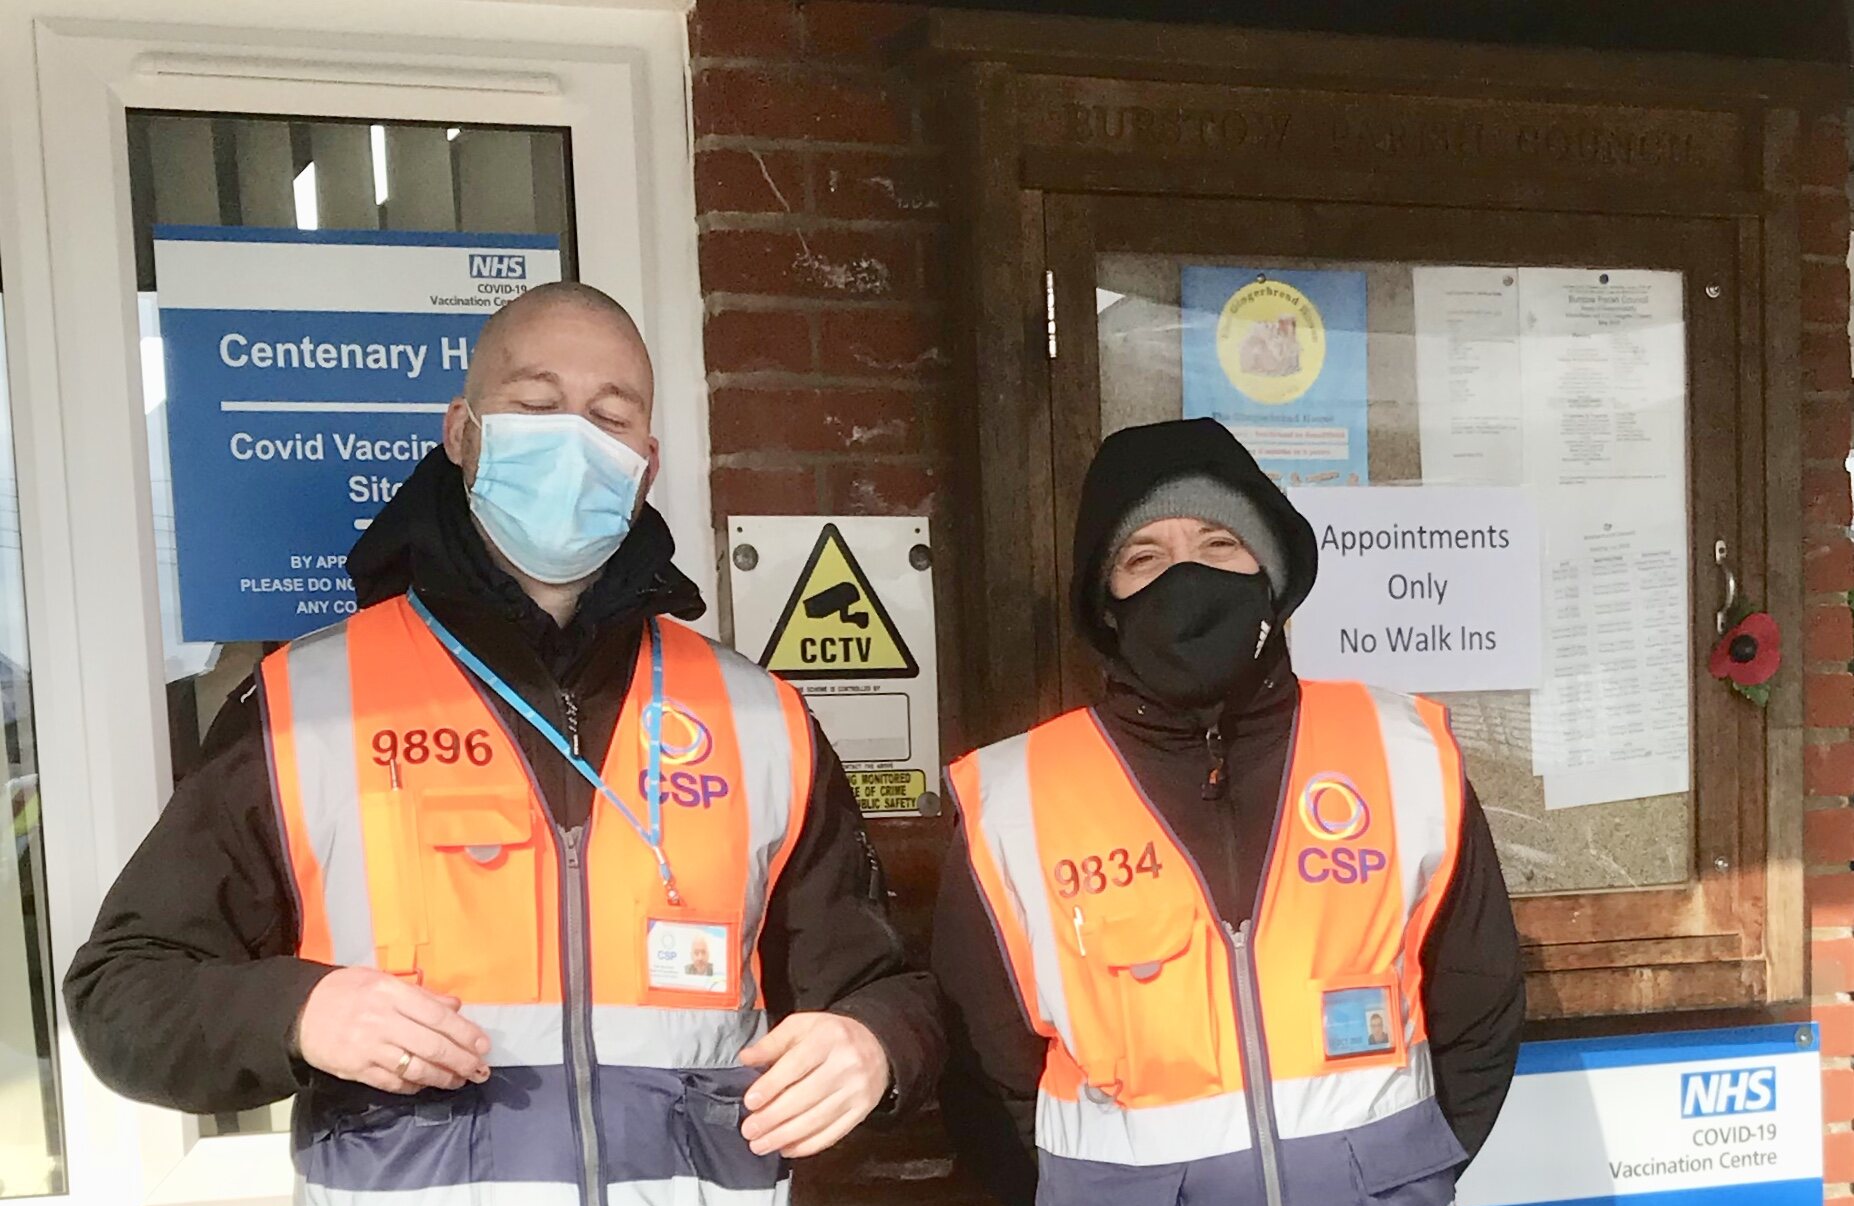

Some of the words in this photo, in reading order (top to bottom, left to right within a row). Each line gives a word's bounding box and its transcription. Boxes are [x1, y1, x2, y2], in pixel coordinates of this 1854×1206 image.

[471, 256, 523, 278] NHS
[430, 296, 491, 307] Vaccination
[478, 284, 527, 294] COVID-19
[219, 333, 427, 378] Centenary
[441, 336, 475, 370] H
[230, 432, 324, 460] Covid
[1320, 524, 1510, 557] Appointments
[290, 556, 313, 569] BY
[240, 578, 304, 592] PLEASE
[308, 578, 332, 592] DO
[1388, 572, 1448, 606] Only
[296, 601, 329, 614] ANY
[334, 600, 359, 614] CO
[800, 637, 872, 664] CCTV
[1340, 627, 1377, 654] No
[1386, 625, 1452, 653] Walk
[1461, 626, 1497, 651] Ins
[371, 727, 494, 767] 9896
[638, 768, 729, 809] CSP
[861, 772, 911, 785] MONITORED
[864, 786, 876, 796] OF
[880, 785, 907, 796] CRIME
[884, 797, 917, 808] SAFETY
[1054, 840, 1163, 899] 9834
[1298, 846, 1387, 885] CSP
[657, 950, 677, 960] CSP
[1683, 1069, 1774, 1116] NHS
[1692, 1123, 1777, 1147] COVID-19
[1609, 1154, 1713, 1179] Vaccination
[1719, 1150, 1778, 1169] Centre
